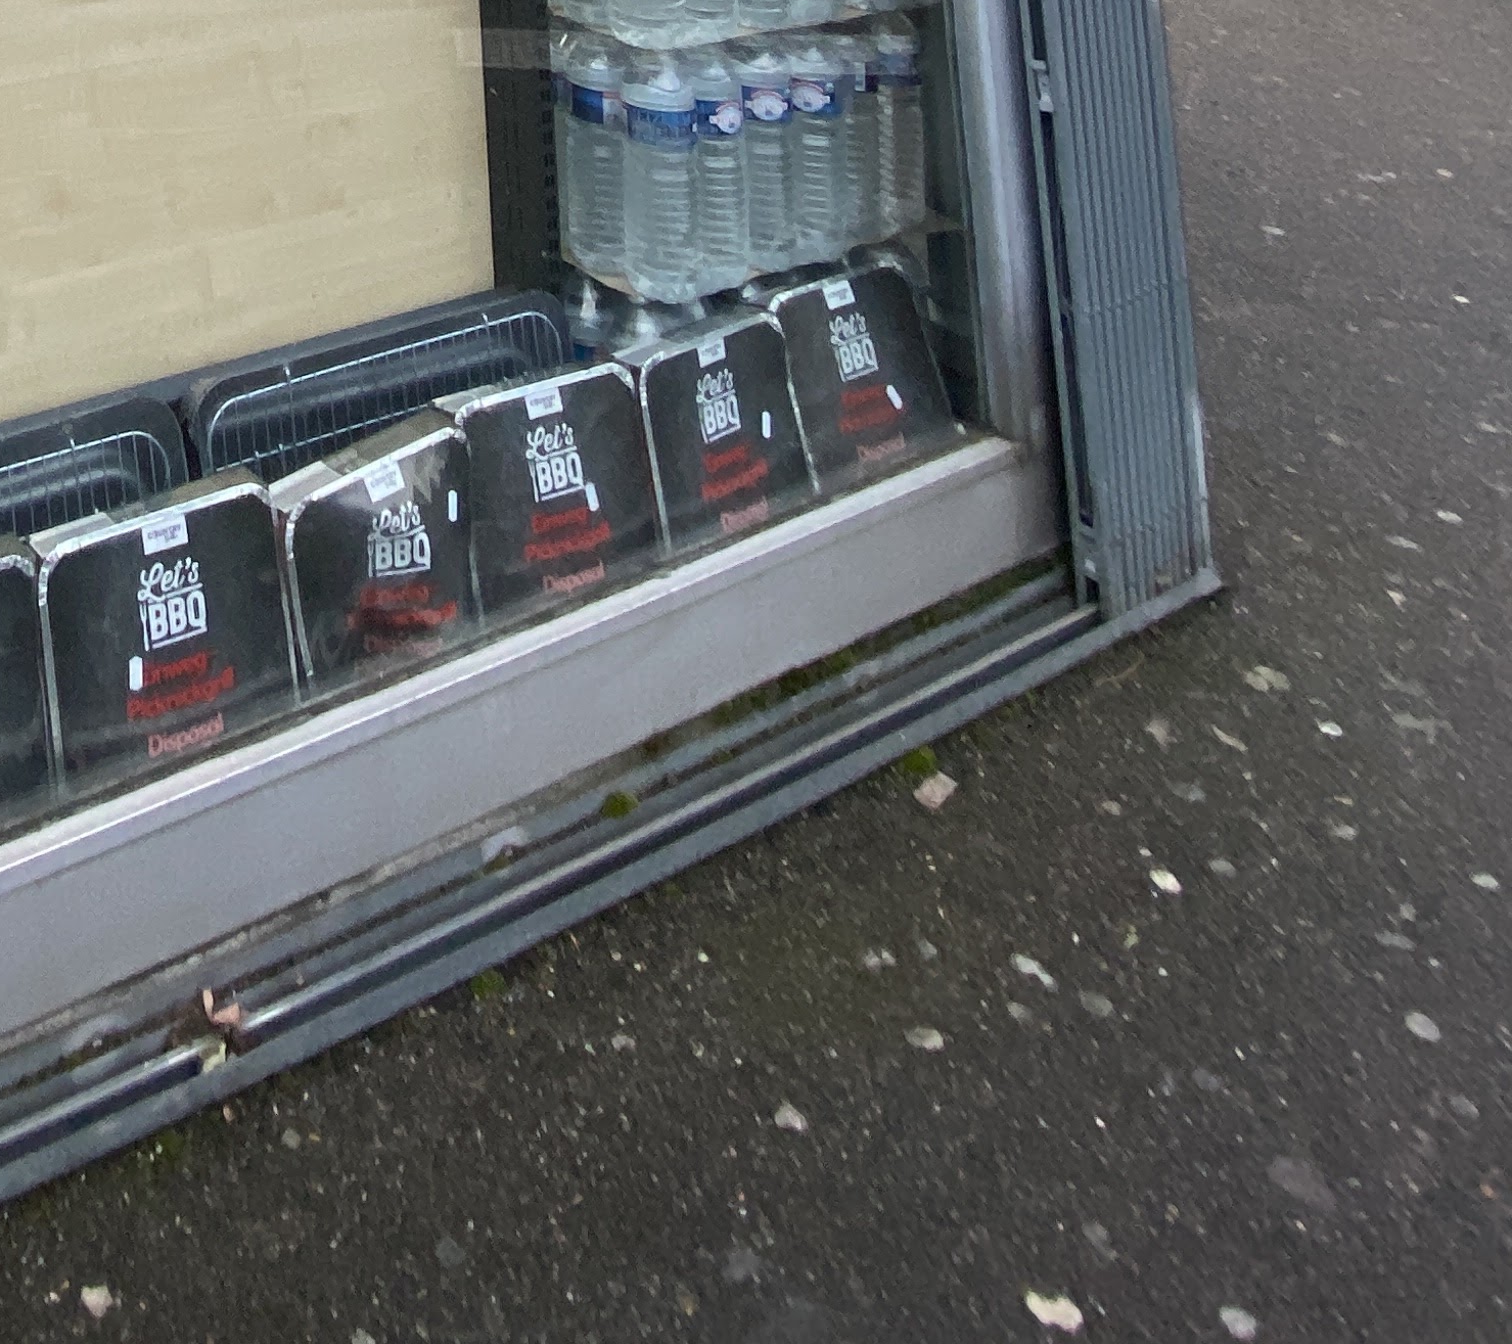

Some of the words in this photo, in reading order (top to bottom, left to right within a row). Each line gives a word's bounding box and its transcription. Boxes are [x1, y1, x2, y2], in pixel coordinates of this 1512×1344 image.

[839, 338, 878, 374] BBQ
[702, 395, 741, 435] BBQ
[526, 423, 574, 460] Let's
[537, 452, 584, 493] BBQ
[375, 531, 431, 570] BBQ
[137, 556, 200, 602] Let's
[148, 590, 207, 641] BBQ
